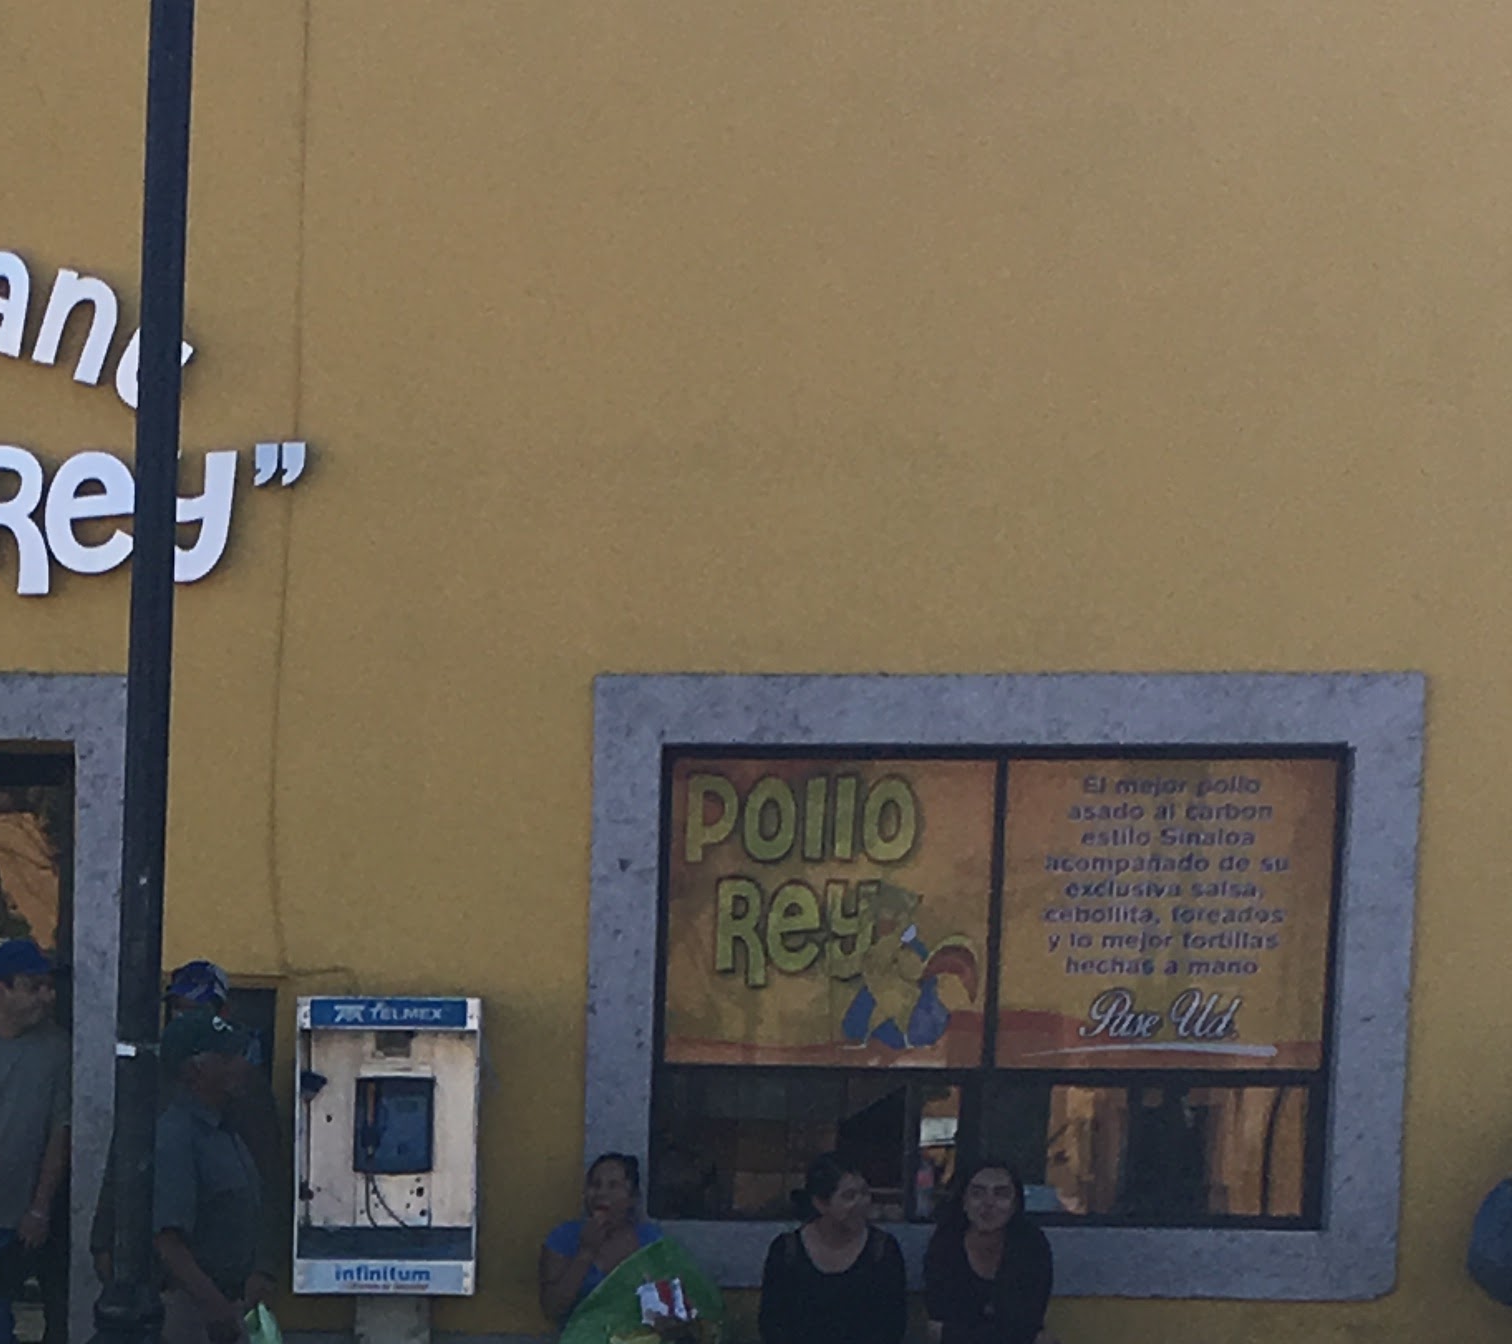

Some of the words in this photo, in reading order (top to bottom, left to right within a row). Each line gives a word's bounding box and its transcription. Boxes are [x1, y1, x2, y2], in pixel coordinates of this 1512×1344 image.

[1083, 775, 1107, 795] El
[1115, 776, 1186, 797] mejor
[1195, 775, 1261, 798] pollo
[684, 771, 917, 864] Pollo
[1068, 802, 1145, 821] asado
[1153, 802, 1176, 821] al
[1185, 803, 1273, 821] carbon
[1080, 827, 1151, 846] estilo
[1160, 827, 1256, 847] Sinaloa
[1045, 853, 1210, 876] acompañado
[1219, 855, 1251, 873] de
[1260, 856, 1289, 873] su
[1065, 880, 1183, 898] exclusiva
[715, 875, 882, 989] Rey
[1048, 933, 1060, 951] y
[1069, 931, 1093, 949] lo
[1101, 931, 1173, 953] mejor
[1182, 931, 1279, 950] tortillas
[1065, 956, 1155, 976] hechas
[1163, 959, 1179, 976] a
[1188, 958, 1259, 975] mano
[369, 1002, 443, 1021] TELMEX
[1078, 988, 1162, 1039] Pase
[334, 1264, 431, 1282] infinitum
